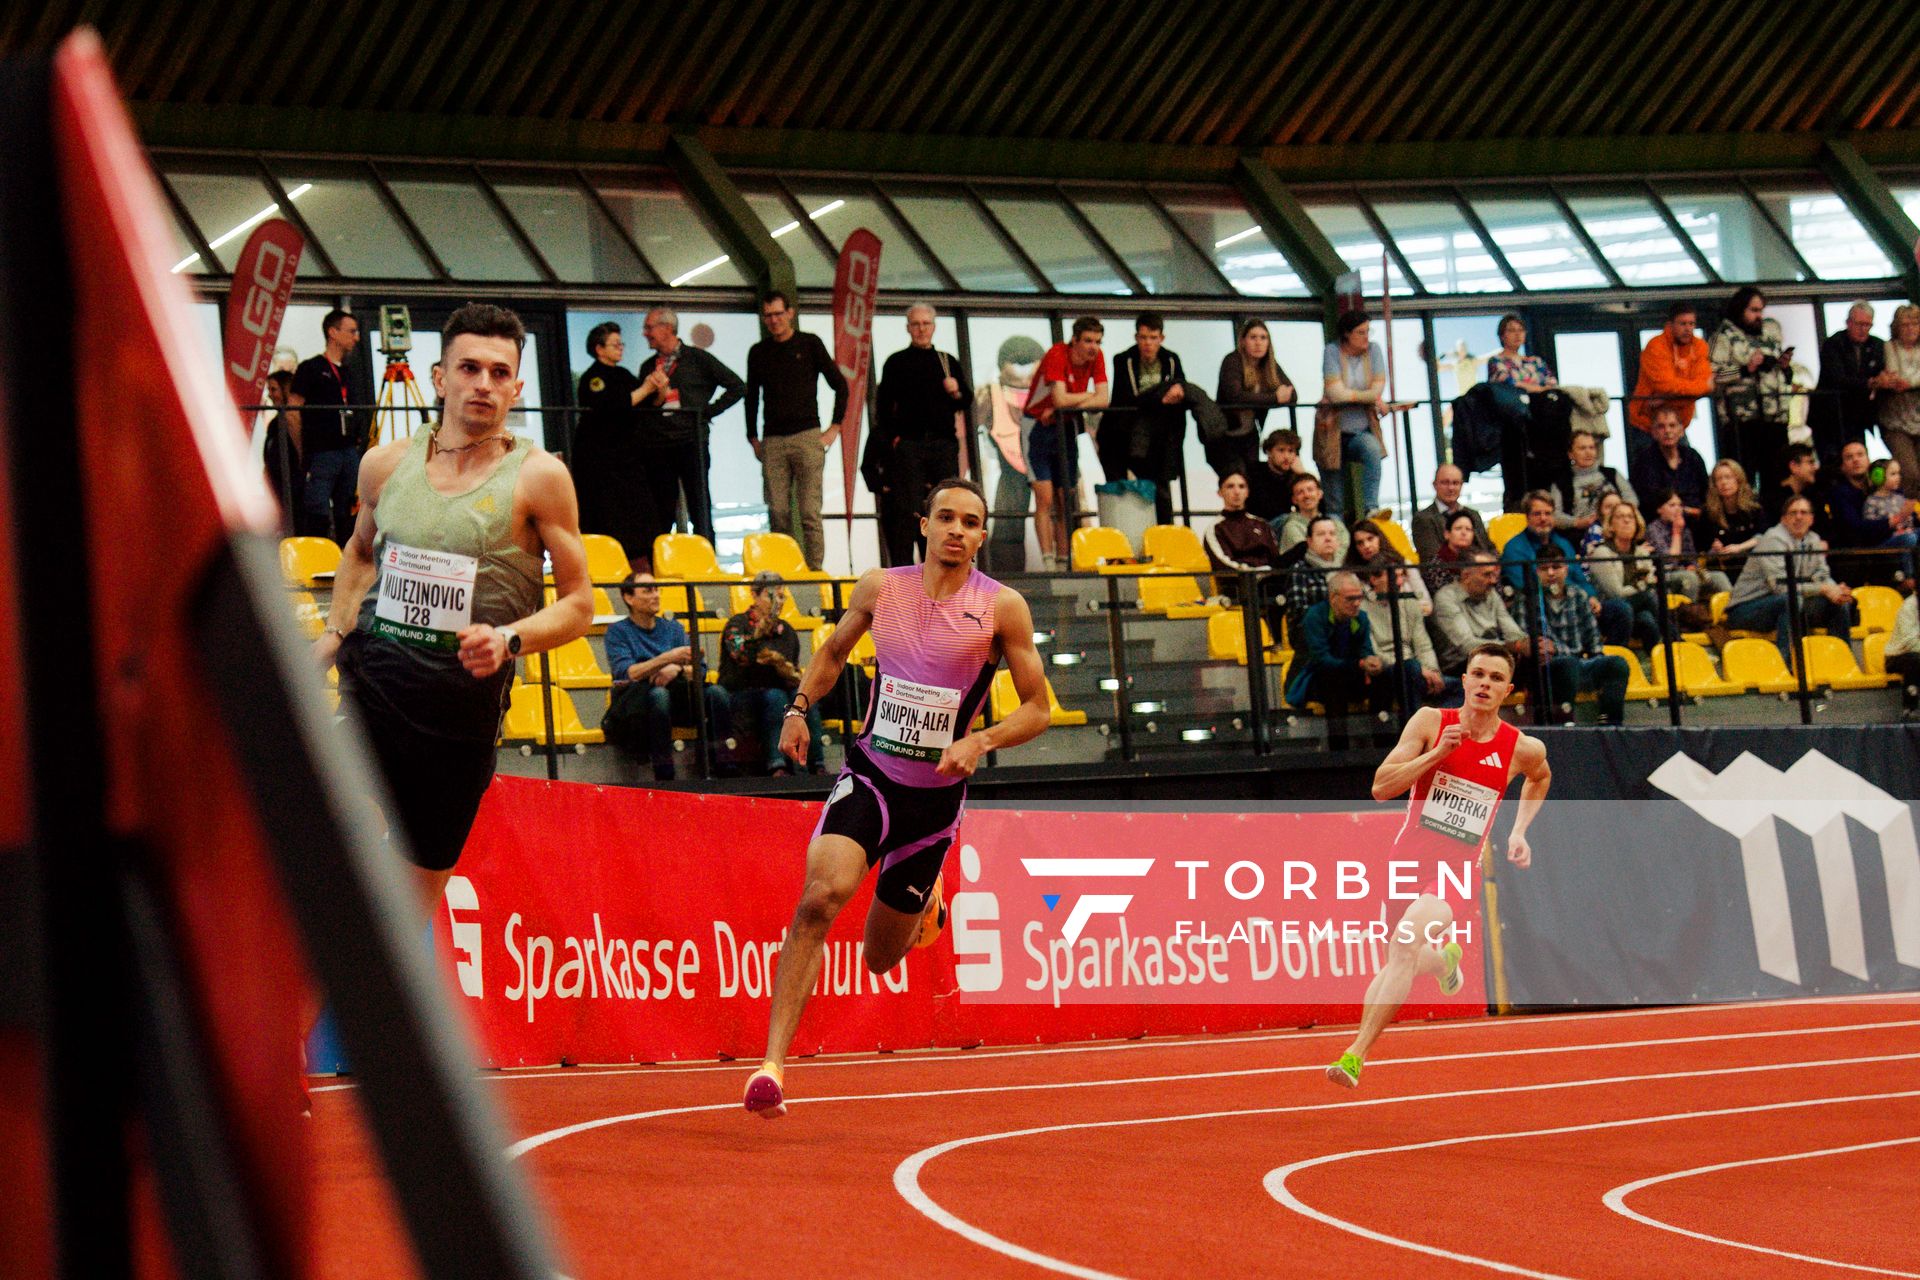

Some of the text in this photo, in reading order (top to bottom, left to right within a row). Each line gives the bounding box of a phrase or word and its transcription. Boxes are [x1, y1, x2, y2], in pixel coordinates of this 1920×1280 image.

[231, 240, 286, 381] LGO
[839, 251, 870, 378] LGO
[420, 553, 452, 566] Meeting
[383, 573, 465, 611] MUJEZINOVIC
[403, 604, 431, 626] 128
[379, 623, 423, 640] DORTMUND
[895, 689, 925, 701] Dortmund
[896, 682, 940, 697] Indoor Meeting
[880, 700, 950, 732] SKUPIN-ALFA
[899, 727, 920, 745] 174
[875, 740, 926, 758] DORTMUND 26
[1432, 788, 1488, 820] WYDERKA
[1444, 811, 1466, 828] 209
[504, 912, 700, 1023] Sparkasse
[1022, 916, 1230, 1008] Sparkasse
